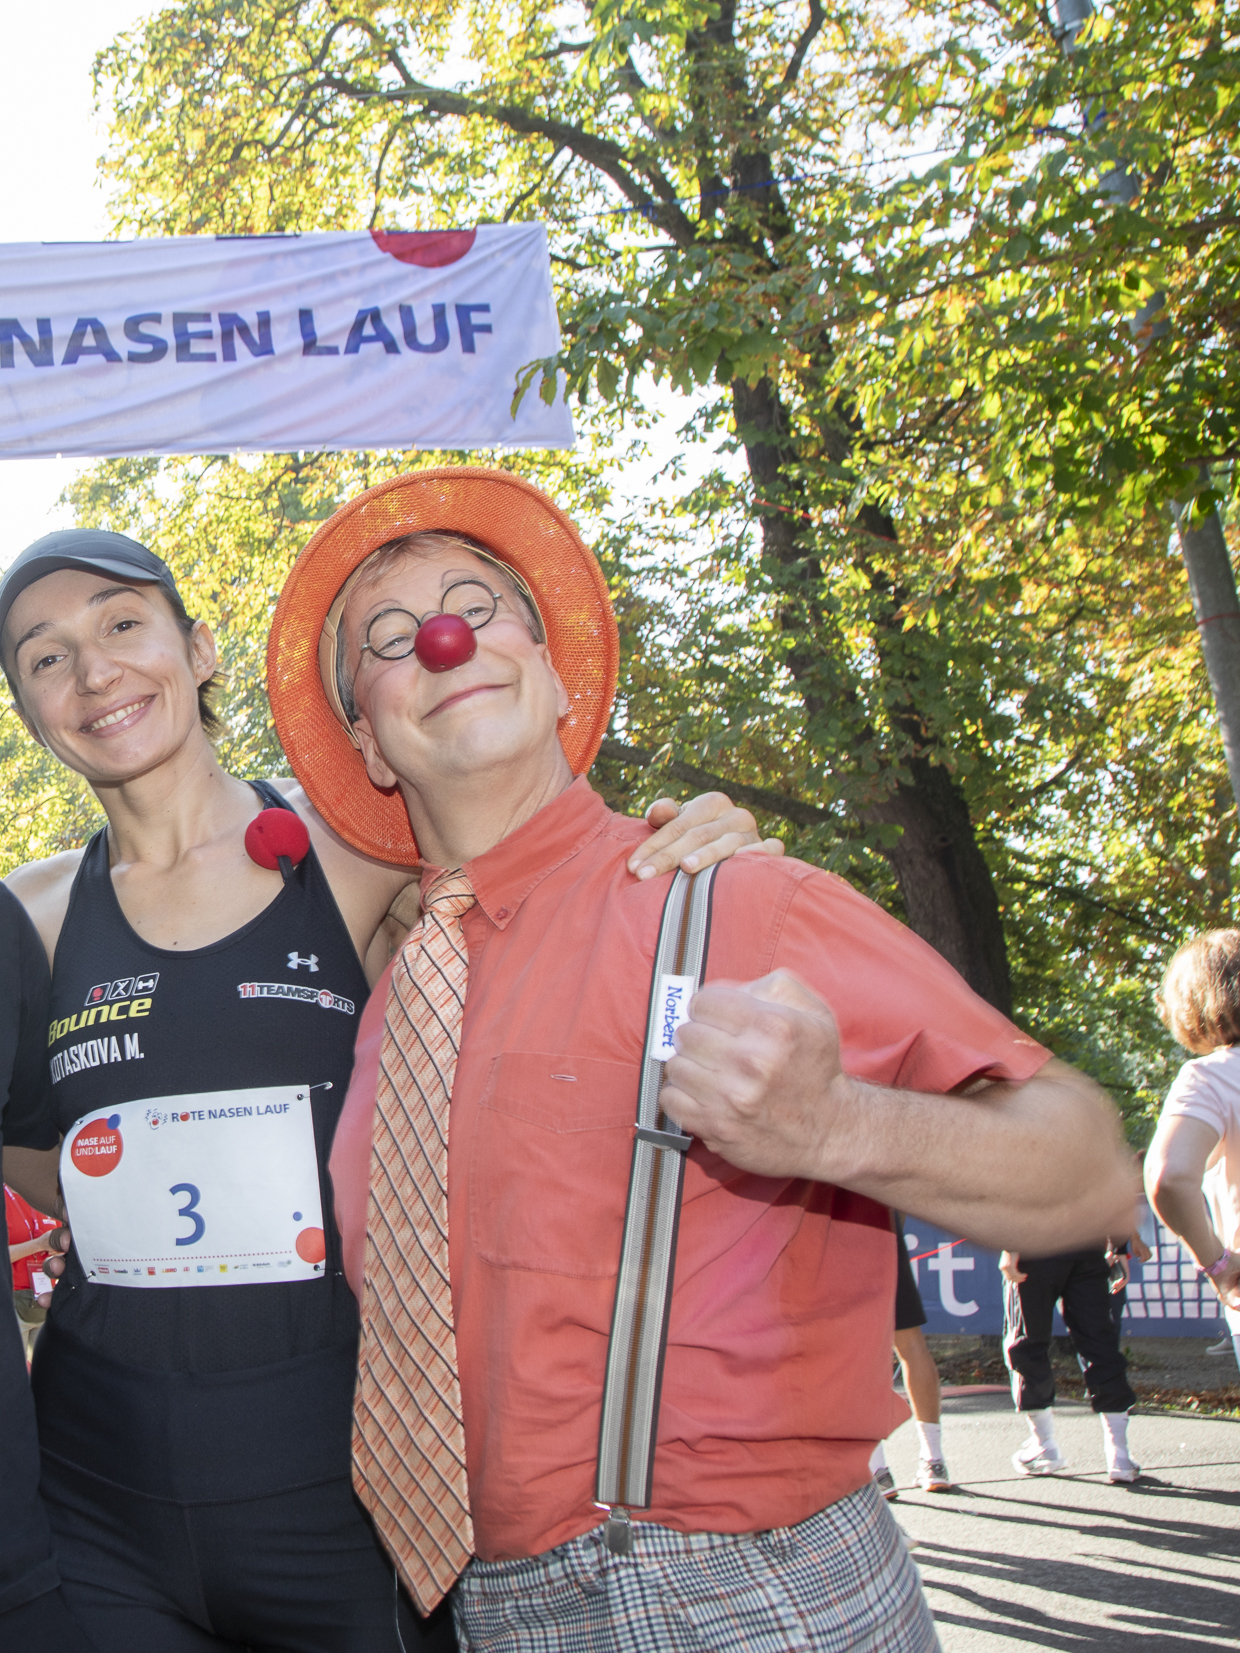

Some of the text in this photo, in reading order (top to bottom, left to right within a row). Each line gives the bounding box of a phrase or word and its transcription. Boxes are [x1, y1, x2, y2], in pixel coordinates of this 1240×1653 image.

[299, 302, 493, 356] LAUF
[662, 985, 683, 1047] Norbert
[124, 1033, 145, 1060] M.
[171, 1103, 290, 1123] ROTE NASEN LAUF
[75, 1145, 118, 1156] UND LAUF
[77, 1136, 116, 1147] NASE AUF
[169, 1183, 206, 1246] 3
